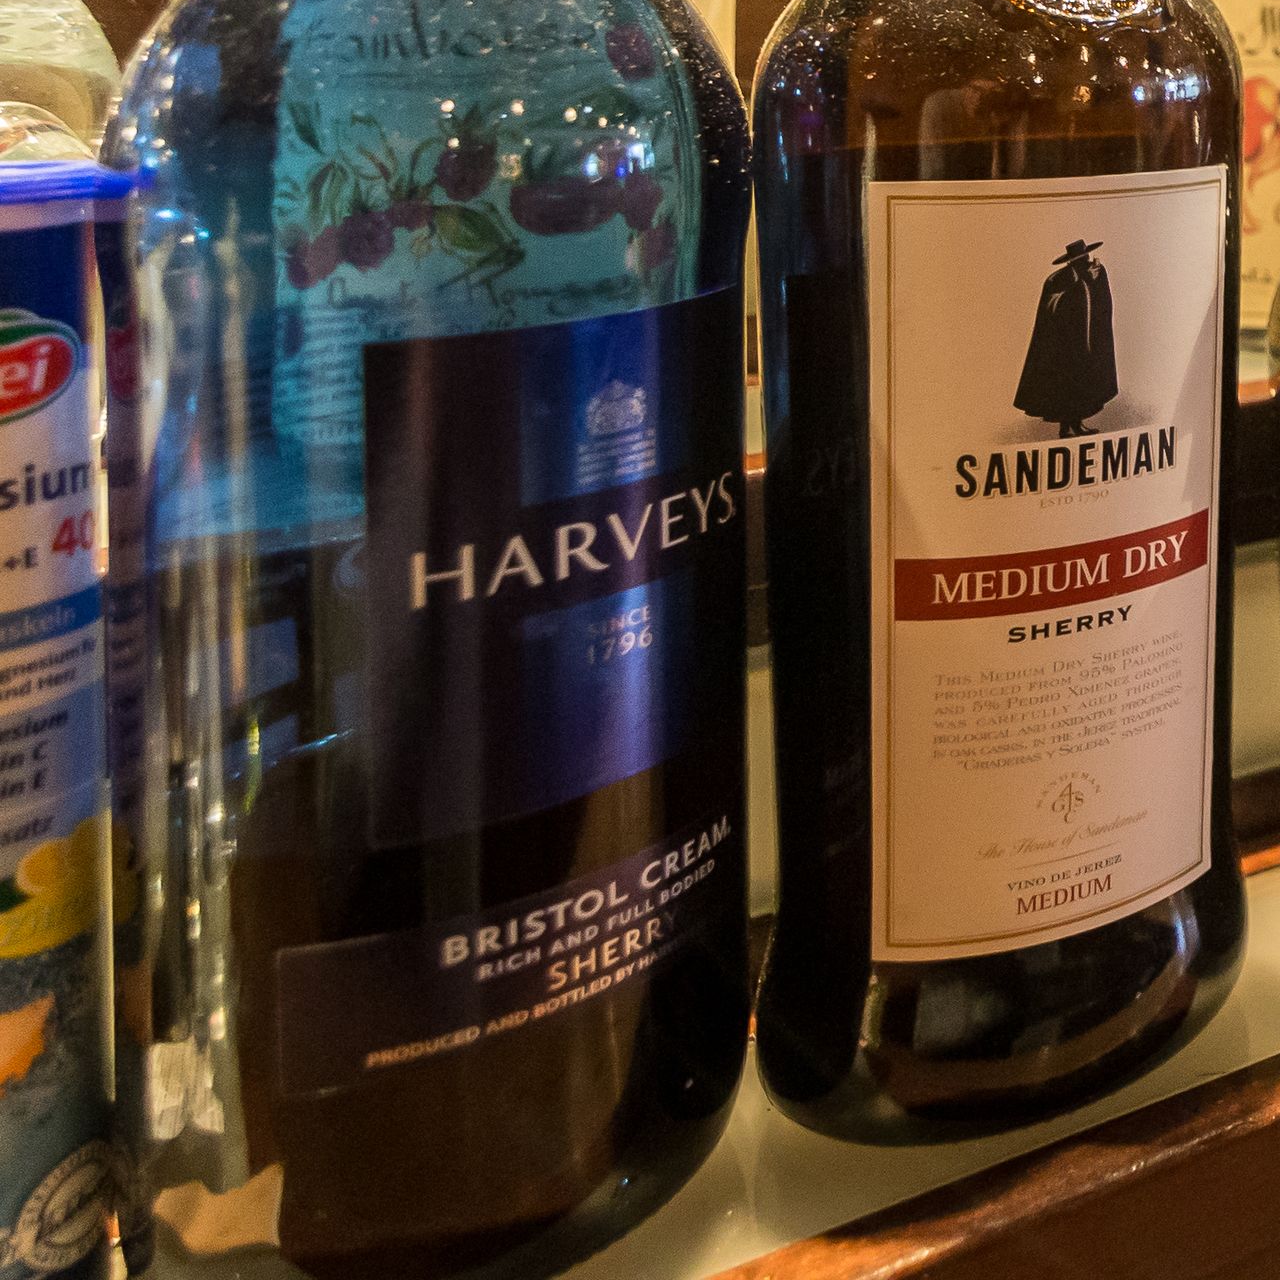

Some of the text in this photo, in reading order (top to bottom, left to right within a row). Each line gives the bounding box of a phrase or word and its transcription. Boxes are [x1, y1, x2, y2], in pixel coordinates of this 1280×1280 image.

[954, 425, 1178, 500] SANDEMAN
[1077, 488, 1110, 505] 1790
[409, 471, 737, 610] HARVEYS
[931, 530, 1189, 605] MEDIUM DRY
[1007, 604, 1133, 643] SHERRY
[934, 685, 1022, 701] PRODUCED
[1028, 677, 1072, 692] FROM
[1122, 641, 1184, 671] PALOMINO
[980, 666, 1046, 683] MEDIUM
[1052, 657, 1086, 673] DRY
[1091, 641, 1149, 665] SHERRY
[1006, 693, 1061, 710] PEDRO
[1067, 674, 1131, 699] XIMENEZ
[1078, 692, 1119, 711] AGED
[1061, 829, 1080, 851] of
[1078, 809, 1149, 840] Sandeman
[1006, 853, 1123, 892] VINO DE JEREZ
[1015, 873, 1113, 916] MEDIUM
[440, 880, 629, 969] BRISTOL
[475, 946, 542, 982] RICH
[549, 924, 600, 957] AND
[607, 900, 655, 932] FULL
[658, 858, 716, 906] BODIED
[548, 908, 680, 992] SHERRY
[365, 964, 635, 1069] PRODUCED AND BOTTLED BY
